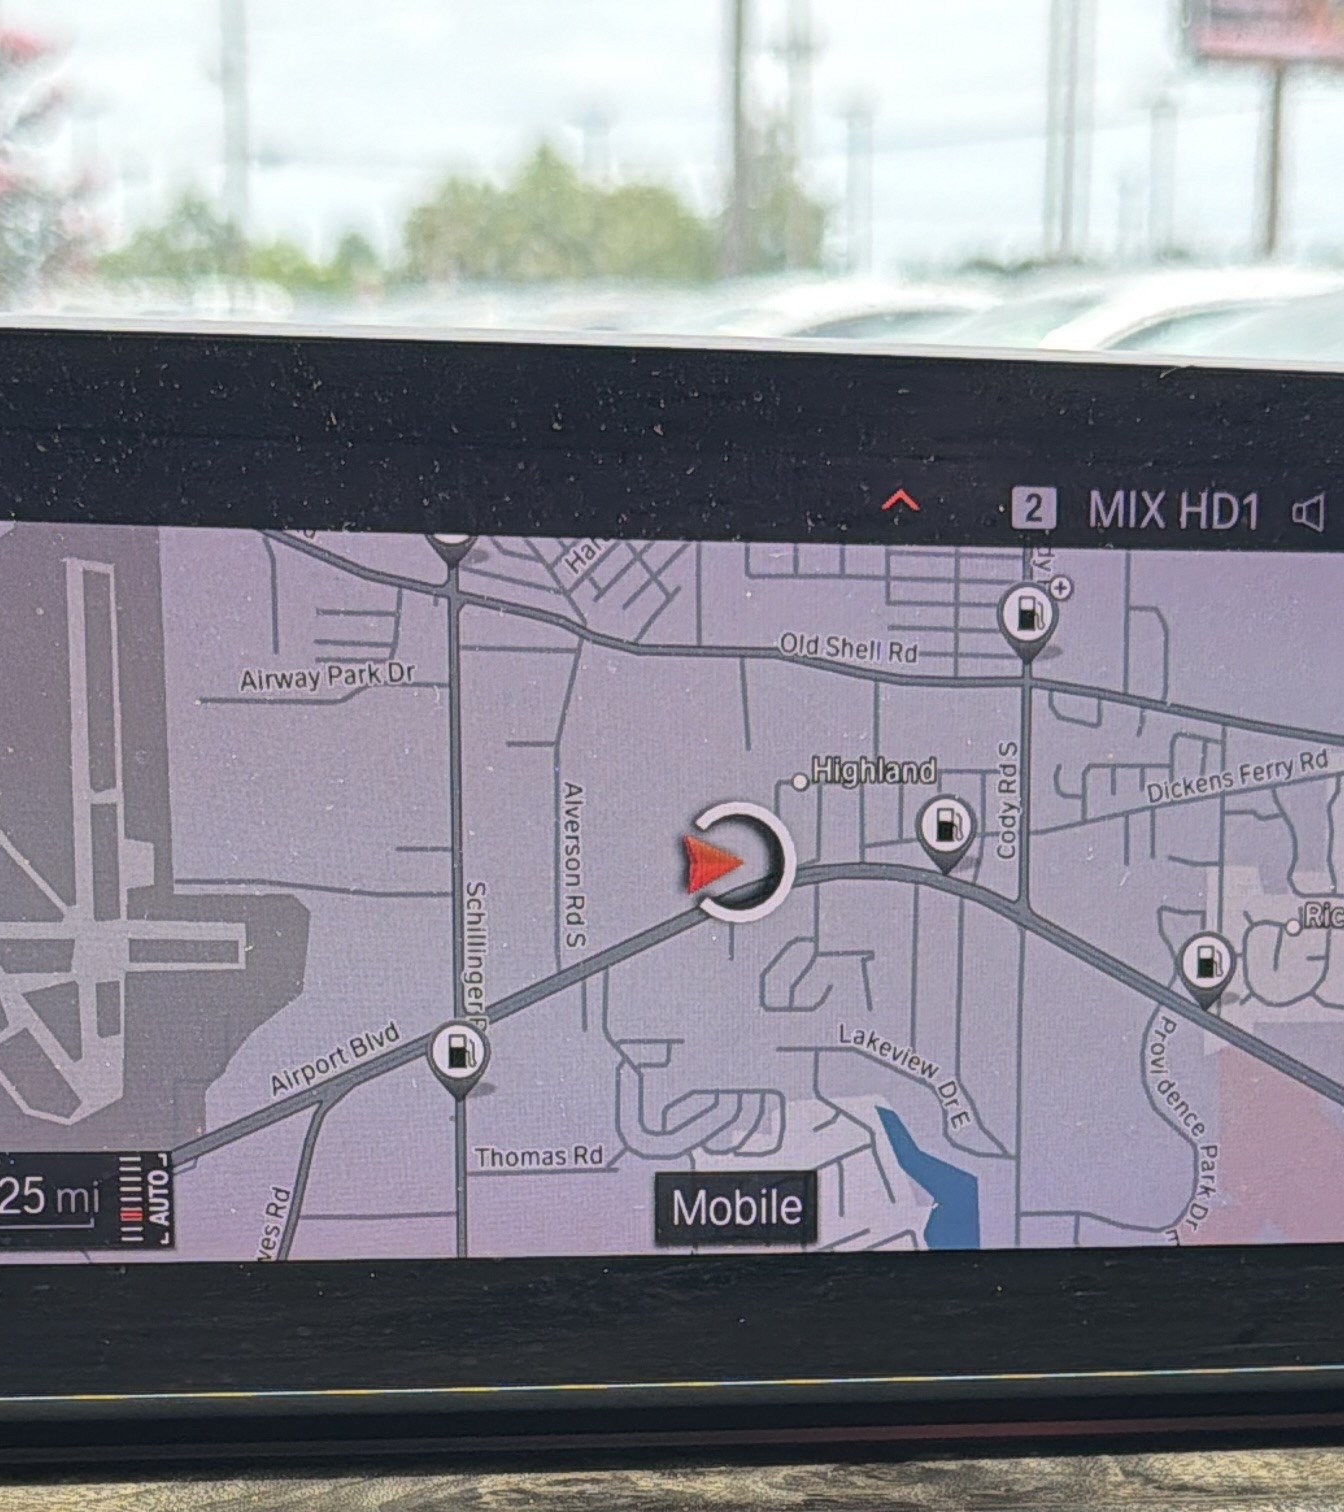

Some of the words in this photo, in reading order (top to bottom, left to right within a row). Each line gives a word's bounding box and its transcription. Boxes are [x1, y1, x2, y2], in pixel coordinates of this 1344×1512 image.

[1025, 493, 1043, 523] 2
[1089, 489, 1166, 529] MIX
[1180, 491, 1257, 530] HD1
[780, 632, 819, 655] Old
[826, 636, 881, 660] Shell
[889, 641, 918, 663] Rd
[240, 669, 320, 692] Airway
[328, 664, 382, 685] Park
[388, 662, 416, 684] Dr
[999, 741, 1017, 757] S
[812, 756, 937, 789] Highland
[998, 763, 1017, 795] Rd
[1147, 770, 1234, 803] Dickens
[1239, 759, 1293, 785] Ferry
[1300, 748, 1329, 772] Rd
[564, 782, 584, 887] Alverson
[996, 803, 1022, 860] Cody
[565, 895, 585, 926] Rd
[464, 881, 487, 1013] Schillinger
[566, 933, 587, 948] S
[271, 1049, 349, 1096] Airport
[351, 1023, 401, 1056] Blvd
[839, 1023, 940, 1079] Lakeview
[938, 1080, 960, 1108] Dr
[950, 1111, 971, 1129] E
[475, 1147, 566, 1167] Thomas
[574, 1145, 604, 1165] Rd
[1200, 1145, 1218, 1198] Park
[57, 1180, 100, 1213] mi
[147, 1170, 170, 1228] AUTO
[265, 1186, 291, 1219] Rd
[672, 1189, 803, 1226] Mobile
[1185, 1203, 1209, 1231] Dr
